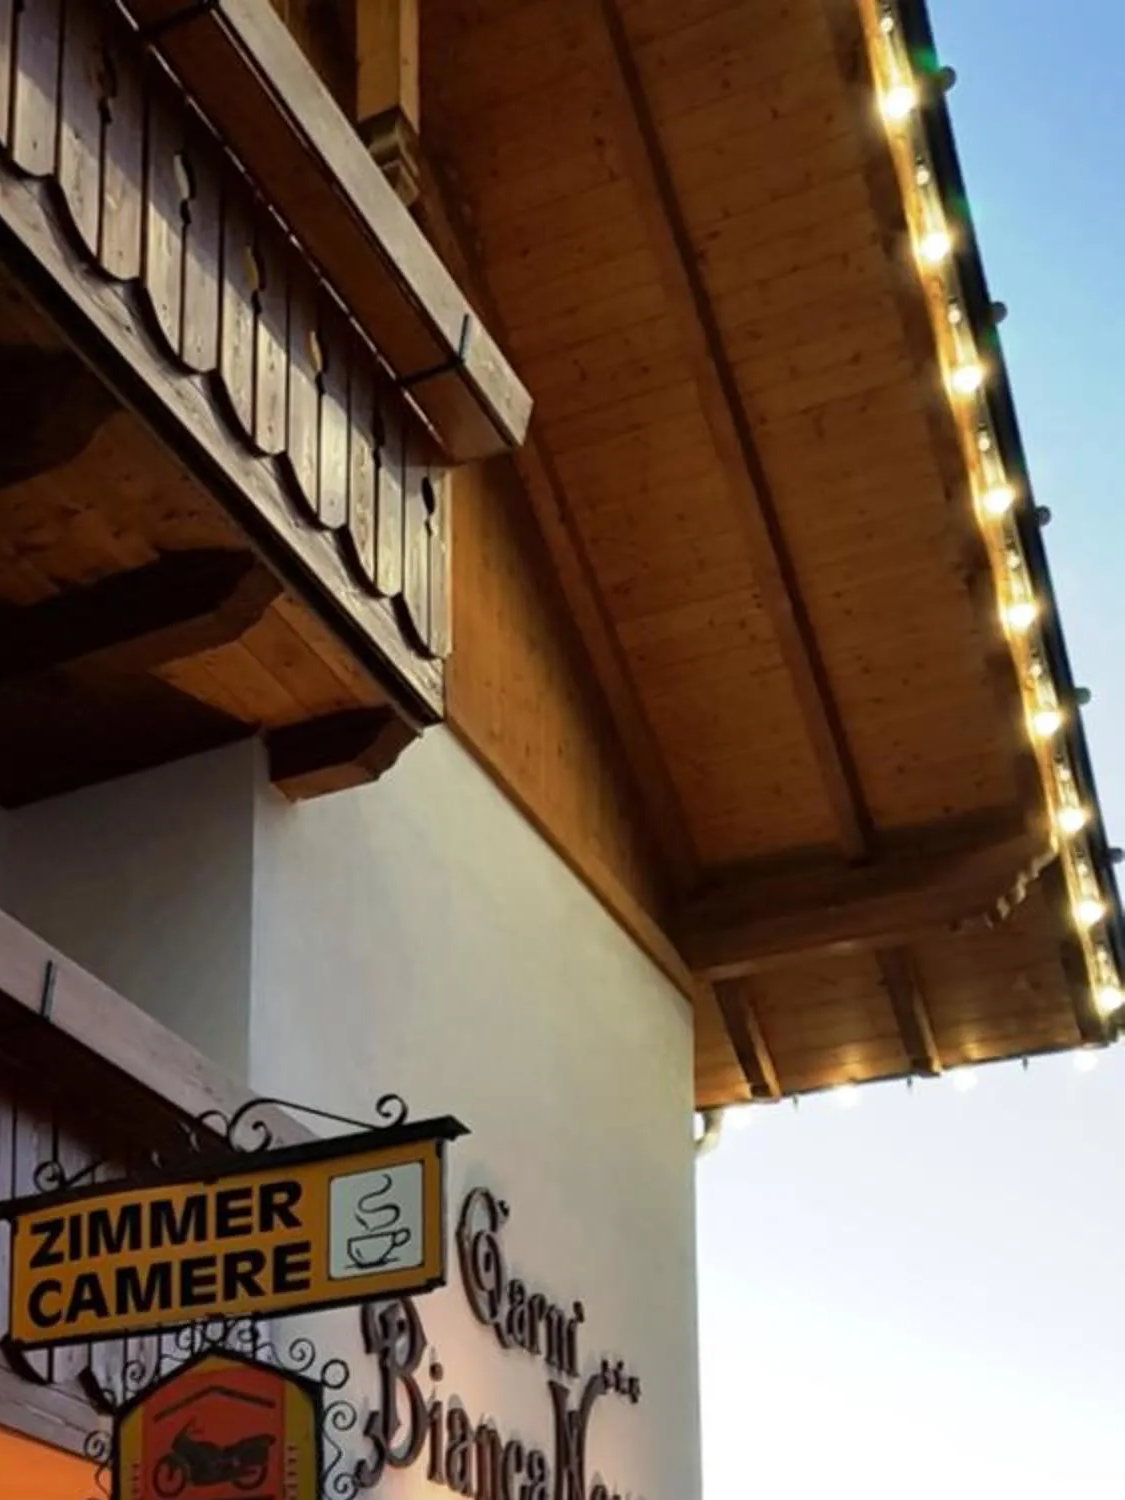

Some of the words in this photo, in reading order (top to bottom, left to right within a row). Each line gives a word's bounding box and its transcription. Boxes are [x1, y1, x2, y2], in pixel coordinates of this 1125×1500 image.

[29, 1181, 303, 1270] ZIMMER
[28, 1240, 312, 1328] CAMERE
[456, 1187, 585, 1378] Garni
